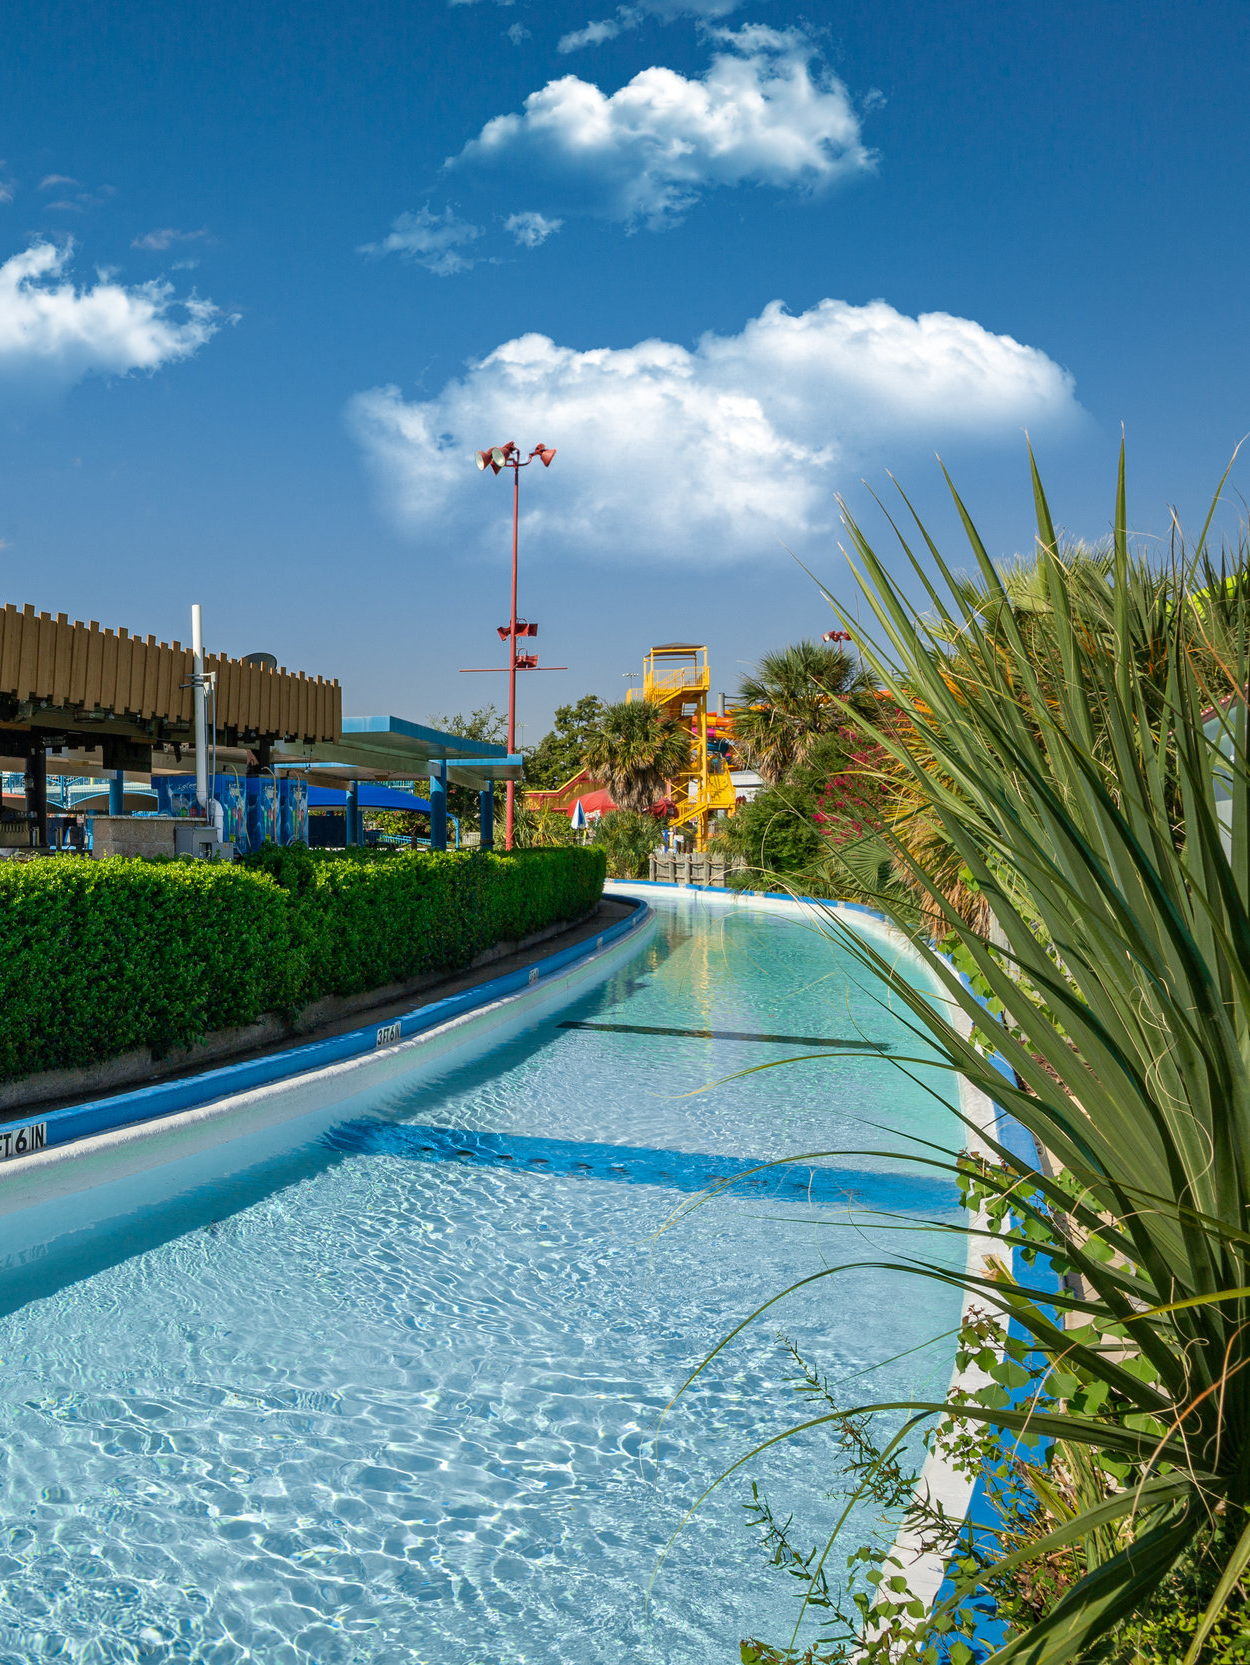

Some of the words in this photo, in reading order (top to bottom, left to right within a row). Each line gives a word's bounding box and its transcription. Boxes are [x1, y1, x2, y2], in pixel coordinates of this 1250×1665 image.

[378, 1030, 383, 1045] 3
[390, 1026, 395, 1041] 6
[15, 1128, 28, 1154] 6
